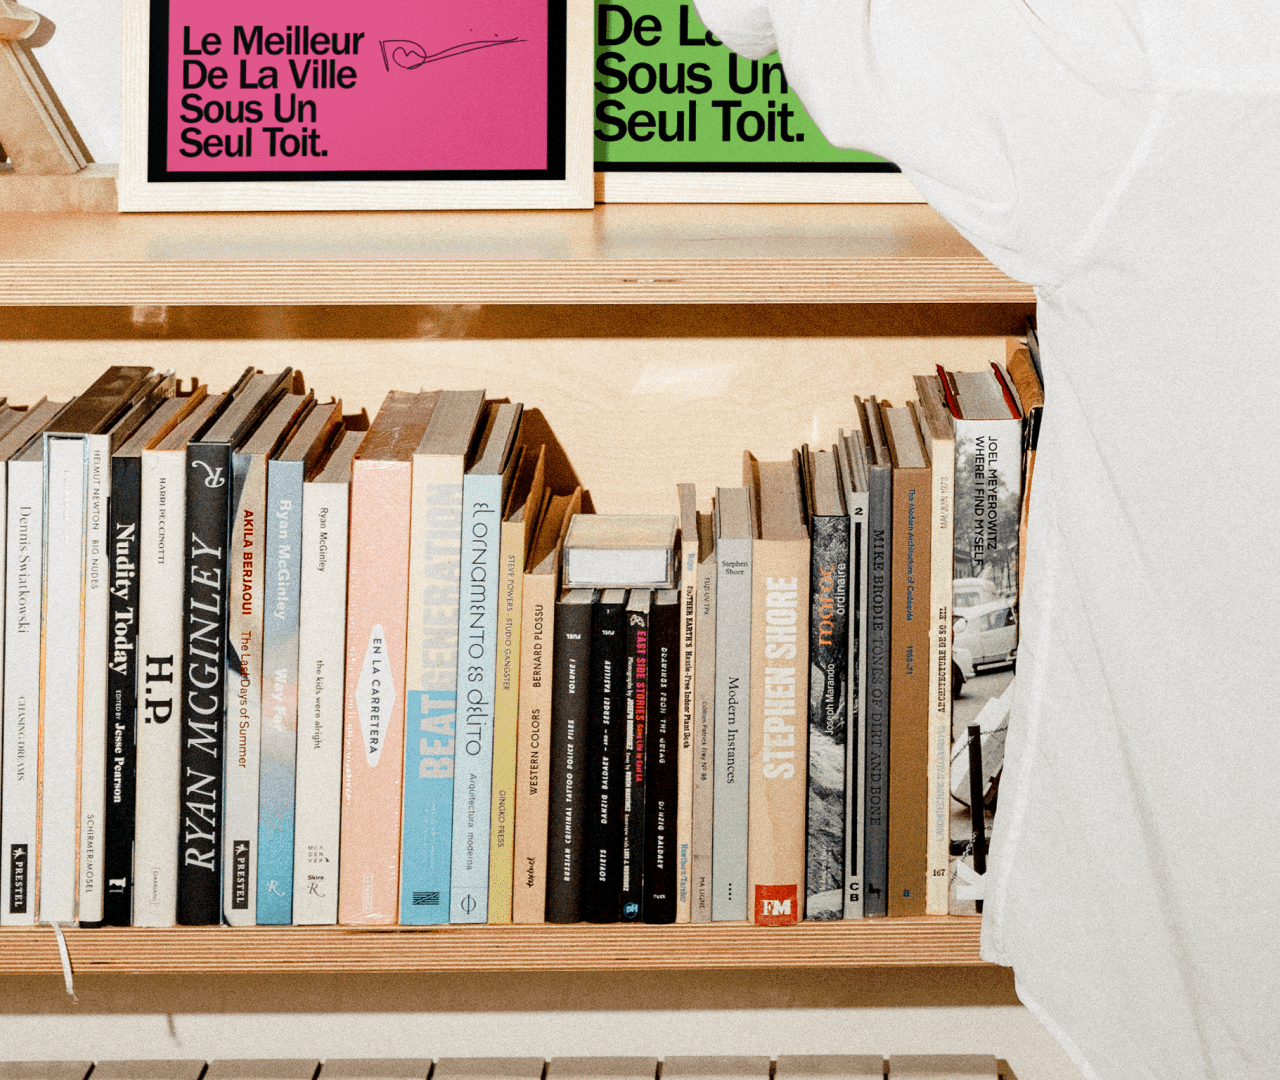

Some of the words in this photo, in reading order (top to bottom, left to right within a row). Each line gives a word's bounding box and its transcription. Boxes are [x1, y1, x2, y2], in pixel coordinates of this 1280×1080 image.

[183, 25, 222, 55] Le
[233, 25, 365, 55] Meilleur
[597, 4, 662, 46] De
[182, 59, 228, 89] De
[240, 59, 278, 89] La
[288, 58, 357, 89] Ville
[594, 52, 712, 95] Sous
[728, 53, 788, 95] Un
[180, 93, 264, 124] Sous
[274, 93, 317, 123] Un
[594, 99, 697, 142] Seul
[712, 100, 804, 142] Toit.
[179, 127, 252, 157] Seul
[262, 127, 328, 157] Toit.
[92, 450, 101, 485] HELMUT
[975, 436, 985, 480] WHERE
[988, 436, 998, 466] JOEL
[92, 488, 100, 530] NEWTON
[276, 500, 291, 541] Ryan
[318, 508, 328, 529] Ryan
[974, 489, 984, 516] FIND
[987, 469, 998, 550] MEYEROWITZ
[18, 506, 31, 551] Dennis
[91, 540, 99, 555] BIG
[158, 509, 166, 564] PECCINOTTI
[243, 509, 254, 548] AKILA
[974, 519, 984, 566] MYSELF
[110, 522, 136, 600] Nudity
[317, 532, 328, 572] McGinley
[507, 554, 515, 577] STEVE
[873, 529, 884, 572] MIKE
[91, 558, 99, 590] NUDES
[241, 552, 253, 615] BERJAOUI
[273, 544, 291, 620] McGinley
[421, 483, 460, 690] GENERATION
[17, 556, 30, 633] Swiatkowski
[506, 579, 514, 612] POWERS
[818, 562, 834, 646] maroc
[835, 563, 846, 615] ordinaire
[872, 575, 884, 631] BRODIE
[504, 618, 513, 647] STUDIO
[534, 604, 544, 640] PLOSSU
[765, 577, 798, 660] SHORE
[109, 607, 134, 676] Today
[189, 532, 222, 759] MCGINLEY
[241, 631, 251, 652] The
[373, 638, 382, 654] EN
[636, 630, 646, 654] EAST
[871, 636, 883, 684] TONES
[240, 654, 251, 677] Last
[314, 660, 324, 674] the
[372, 660, 381, 674] LA
[502, 648, 512, 691] GANGSTER
[532, 643, 542, 688] BERNARD
[636, 658, 646, 679] SIDE
[825, 664, 834, 703] Marando
[145, 654, 174, 724] H.P.
[237, 678, 250, 706] Days
[314, 676, 324, 695] kids
[635, 682, 645, 721] STORIES
[728, 676, 740, 725] Modern
[871, 688, 882, 706] OF
[240, 708, 250, 719] of
[314, 696, 322, 718] were
[369, 679, 381, 754] CARRETERA
[763, 667, 795, 779] STEPHEN
[825, 704, 836, 735] Joseph
[114, 722, 126, 754] Jesse
[238, 721, 249, 768] Summer
[312, 720, 322, 750] alright
[419, 694, 457, 779] BEAT
[530, 709, 540, 748] COLORS
[567, 719, 575, 740] FILES
[870, 712, 882, 748] DIRT
[529, 751, 539, 796] WESTERN
[566, 743, 574, 770] POLICE
[726, 728, 738, 784] Instances
[870, 752, 882, 783] AND
[113, 757, 125, 804] Pearson
[565, 772, 573, 803] TATTOO
[185, 767, 216, 872] RYAN
[564, 807, 572, 844] CRIMINAL
[870, 787, 882, 826] BONE
[14, 861, 23, 907] PRESTEL
[236, 857, 245, 903] PRESTEL
[563, 848, 571, 882] RUSSIAN
[599, 849, 607, 882] SOVIETS
[762, 900, 791, 915] FM
